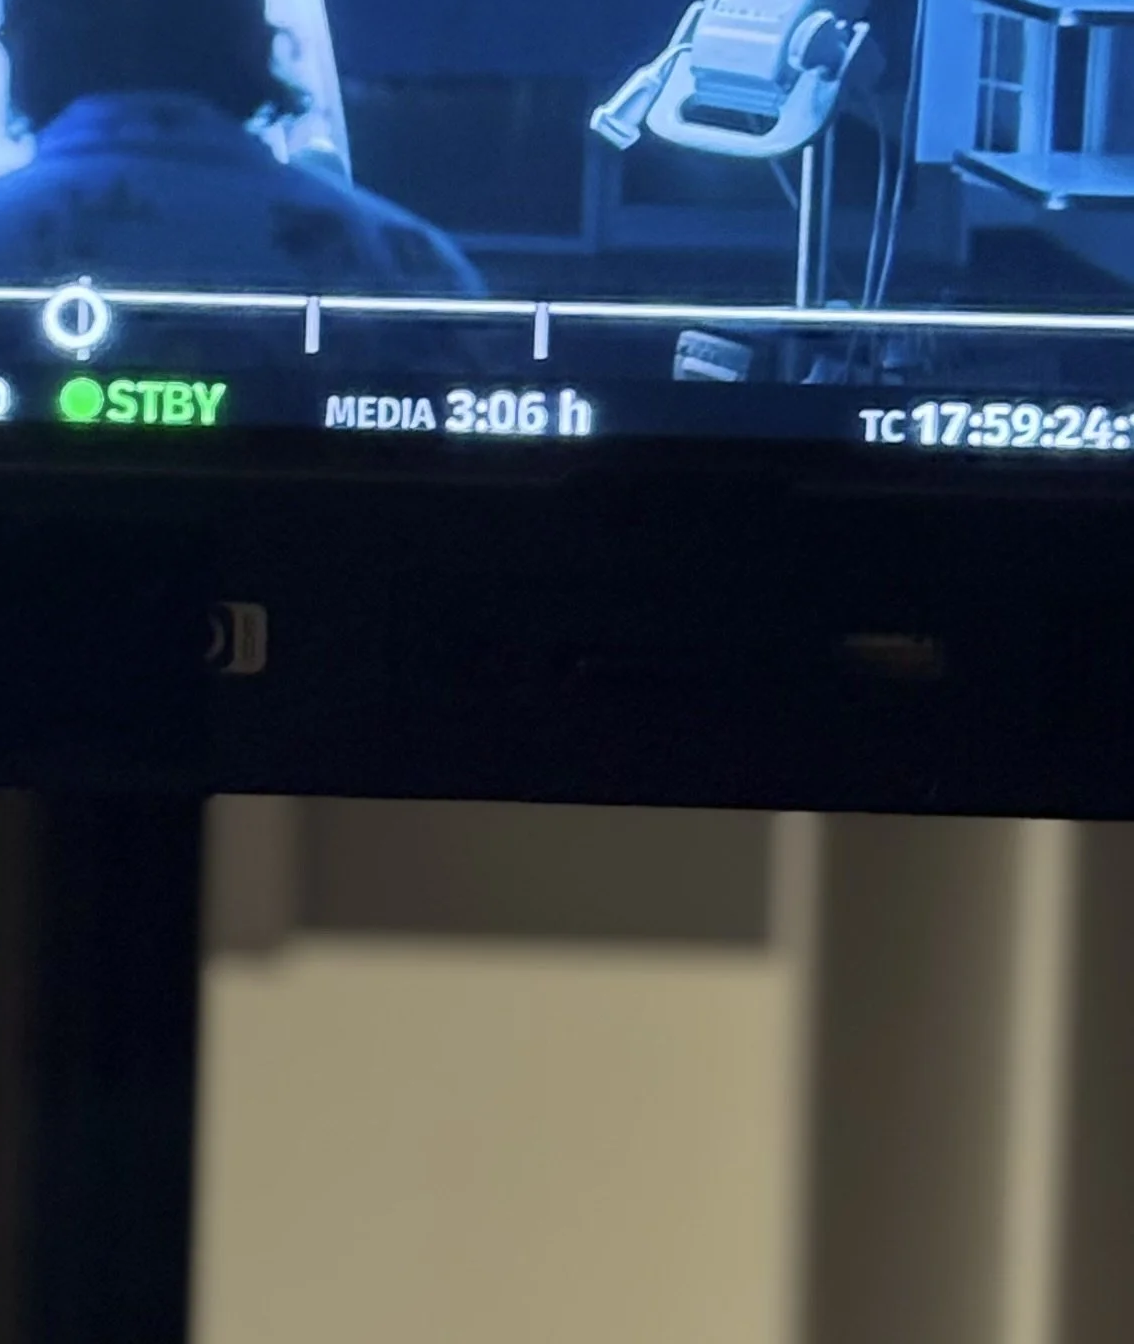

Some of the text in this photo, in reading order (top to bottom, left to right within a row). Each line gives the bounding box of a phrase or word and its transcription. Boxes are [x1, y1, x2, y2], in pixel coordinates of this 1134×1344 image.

[105, 380, 226, 426] STBY
[325, 390, 592, 436] MEDIA 3:06 h
[858, 401, 1134, 450] TC 17:59:24:
